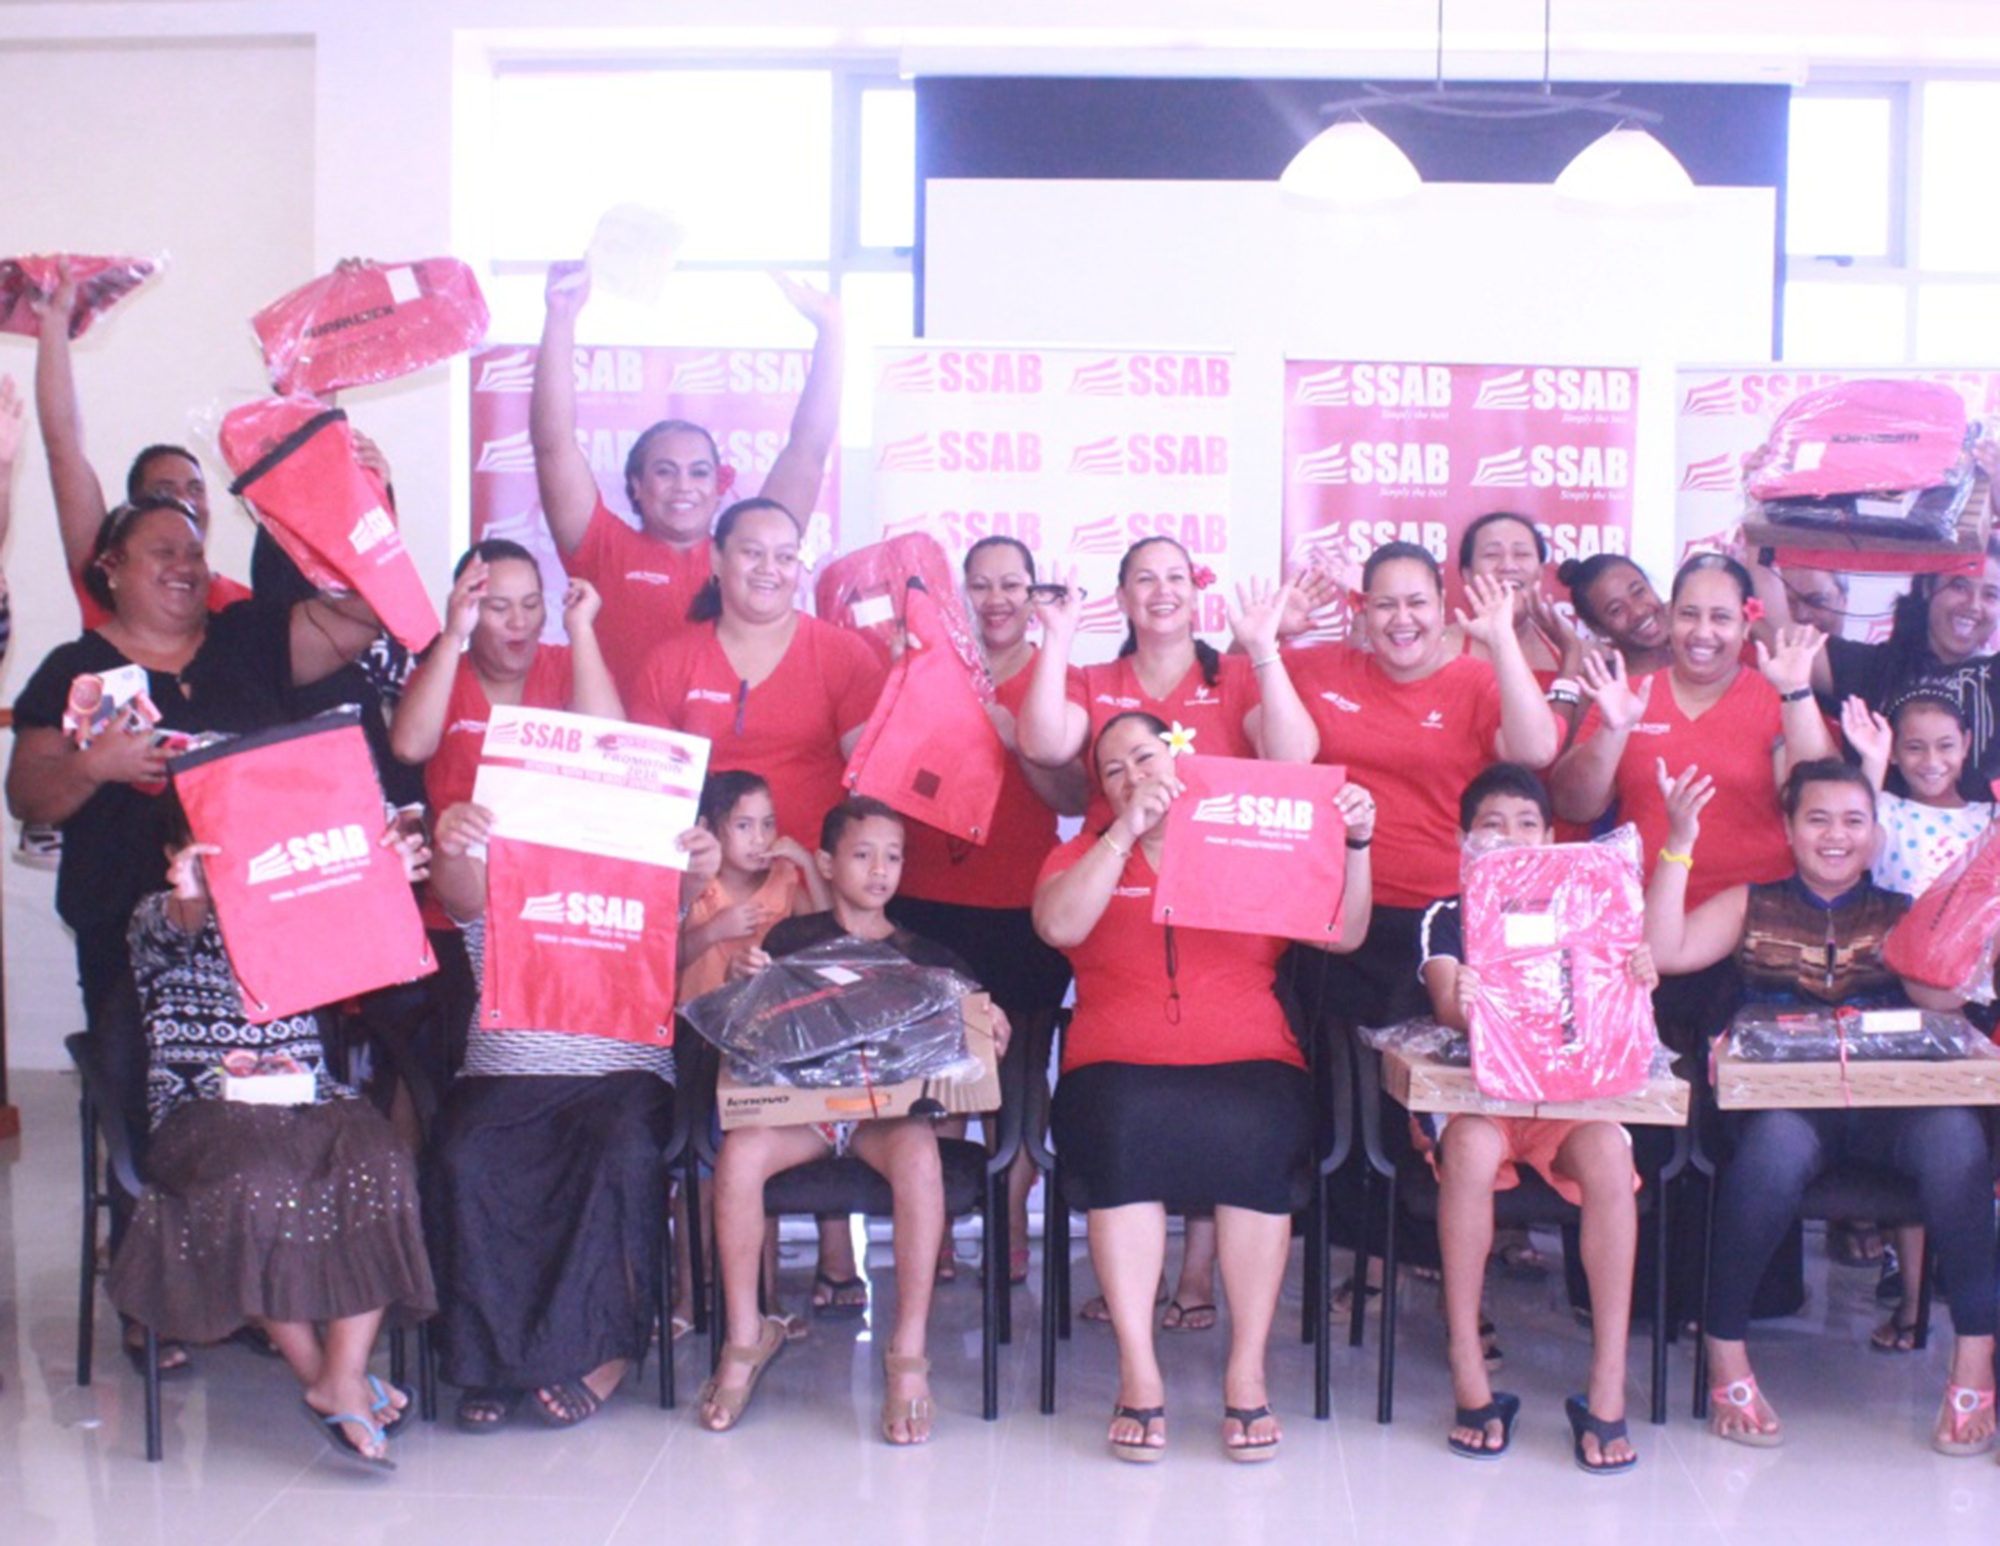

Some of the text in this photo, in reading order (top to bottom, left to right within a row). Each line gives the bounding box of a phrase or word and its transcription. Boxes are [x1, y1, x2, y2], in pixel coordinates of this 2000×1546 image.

[575, 350, 643, 392] SAB
[939, 352, 1043, 394] SSAB
[1128, 355, 1231, 398] SSAB
[1351, 364, 1452, 407] SSAB
[1532, 368, 1631, 411] SSAB
[939, 431, 1042, 473] SSAB
[1127, 434, 1229, 475] SSAB
[1350, 442, 1450, 485] SSAB
[1530, 445, 1628, 487] SSAB
[519, 722, 583, 753] SSAB
[1237, 794, 1314, 831] SSAB
[286, 824, 370, 871] SSAB
[566, 892, 645, 932] SSAB
